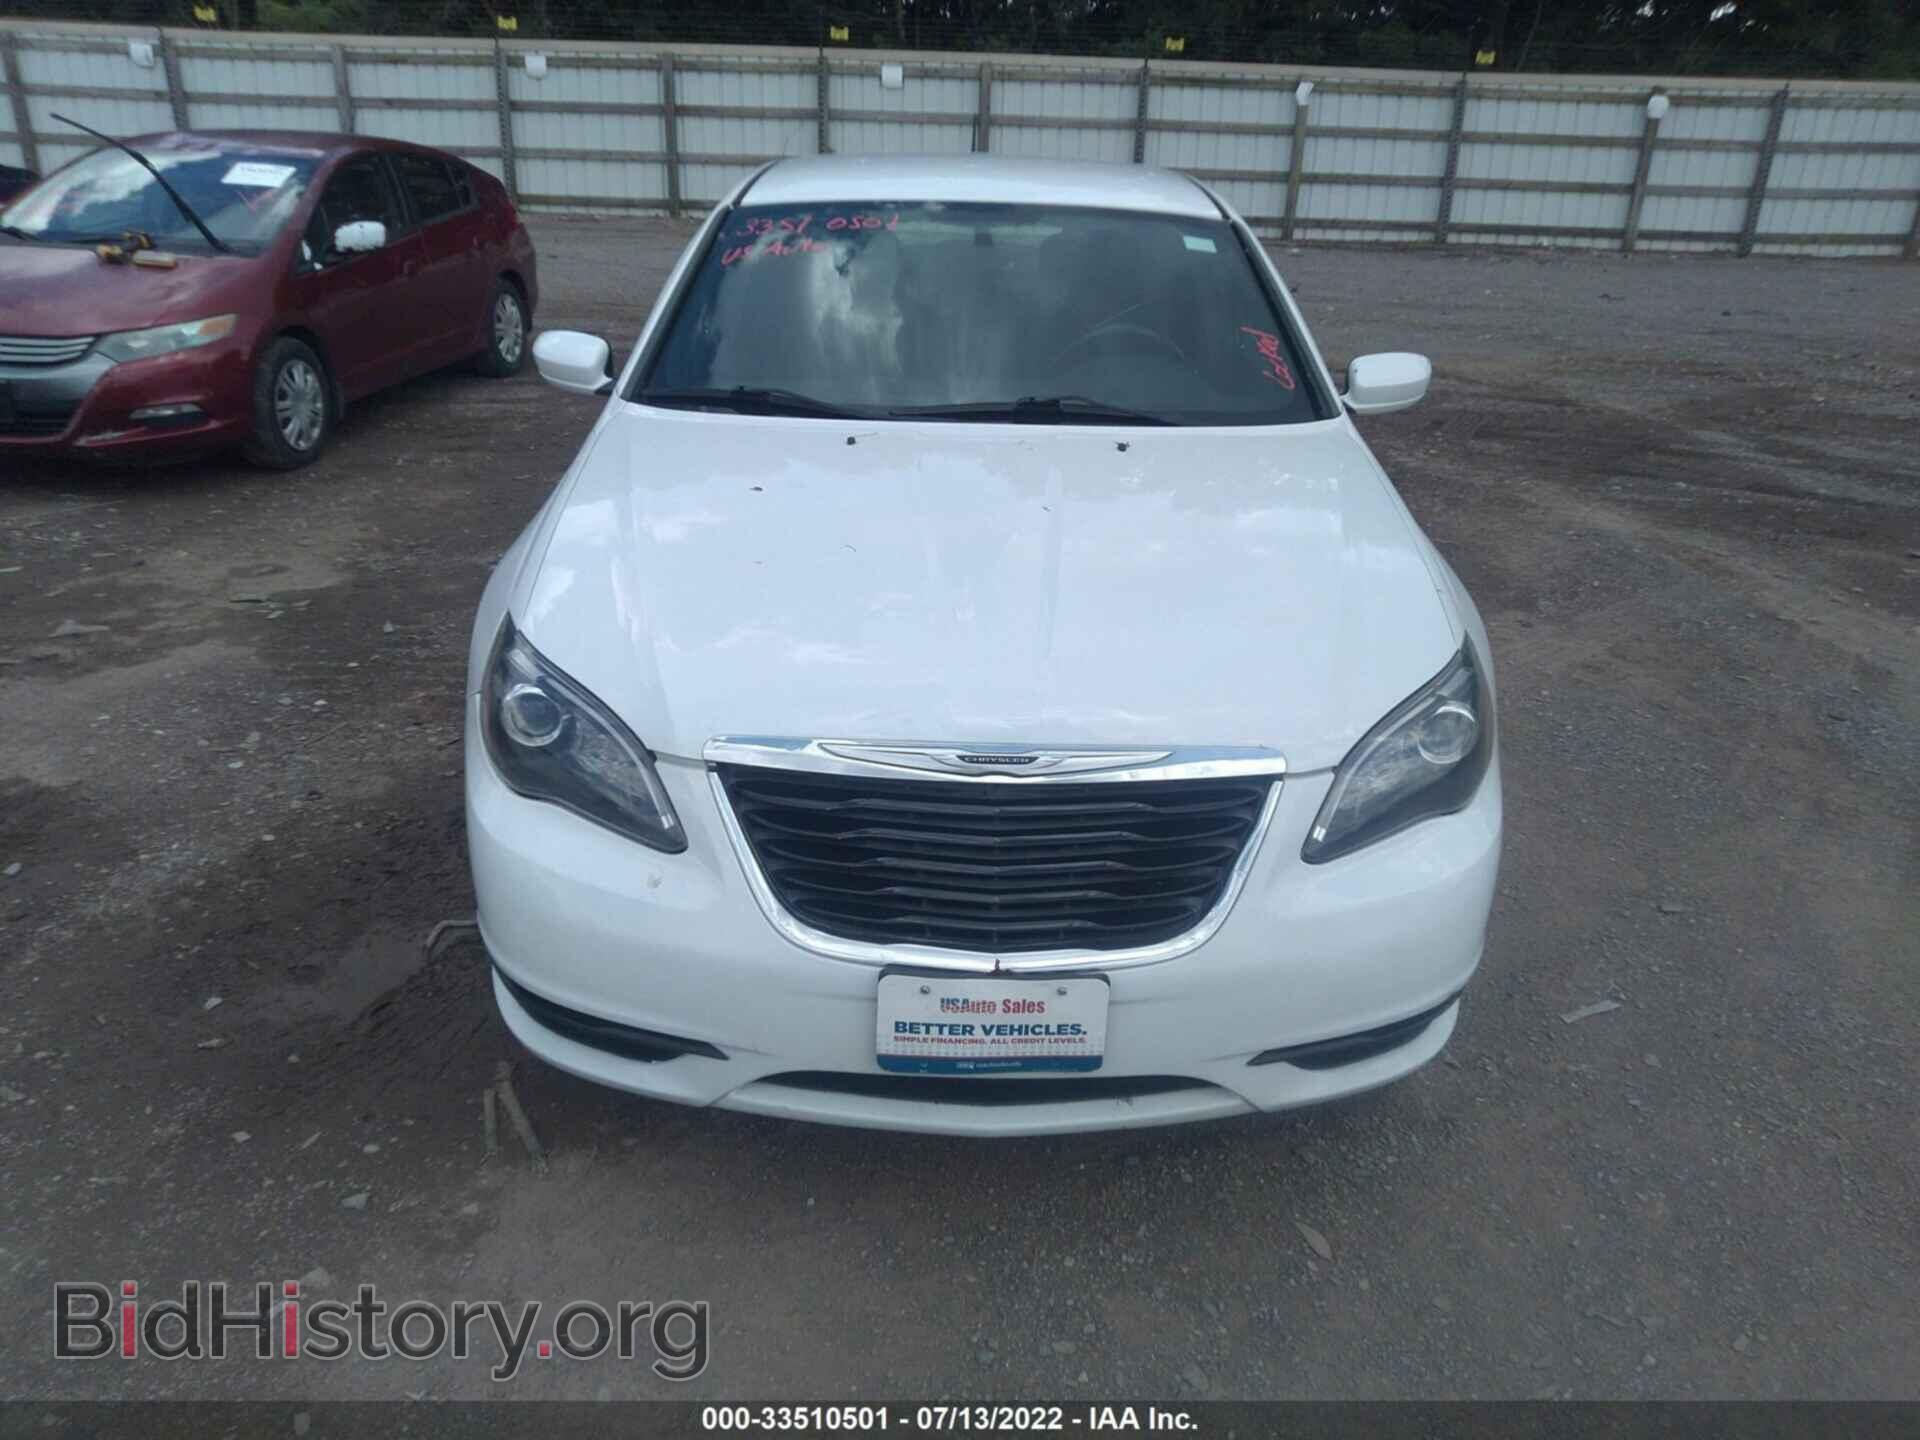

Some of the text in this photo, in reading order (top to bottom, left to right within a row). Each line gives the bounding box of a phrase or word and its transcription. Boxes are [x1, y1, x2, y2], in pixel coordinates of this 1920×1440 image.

[1002, 998, 1046, 1014] Sales
[893, 1020, 1088, 1036] BETTER VEHICLES.
[893, 1036, 929, 1044] SIMPLE
[1011, 1037, 1046, 1045] CREDIT
